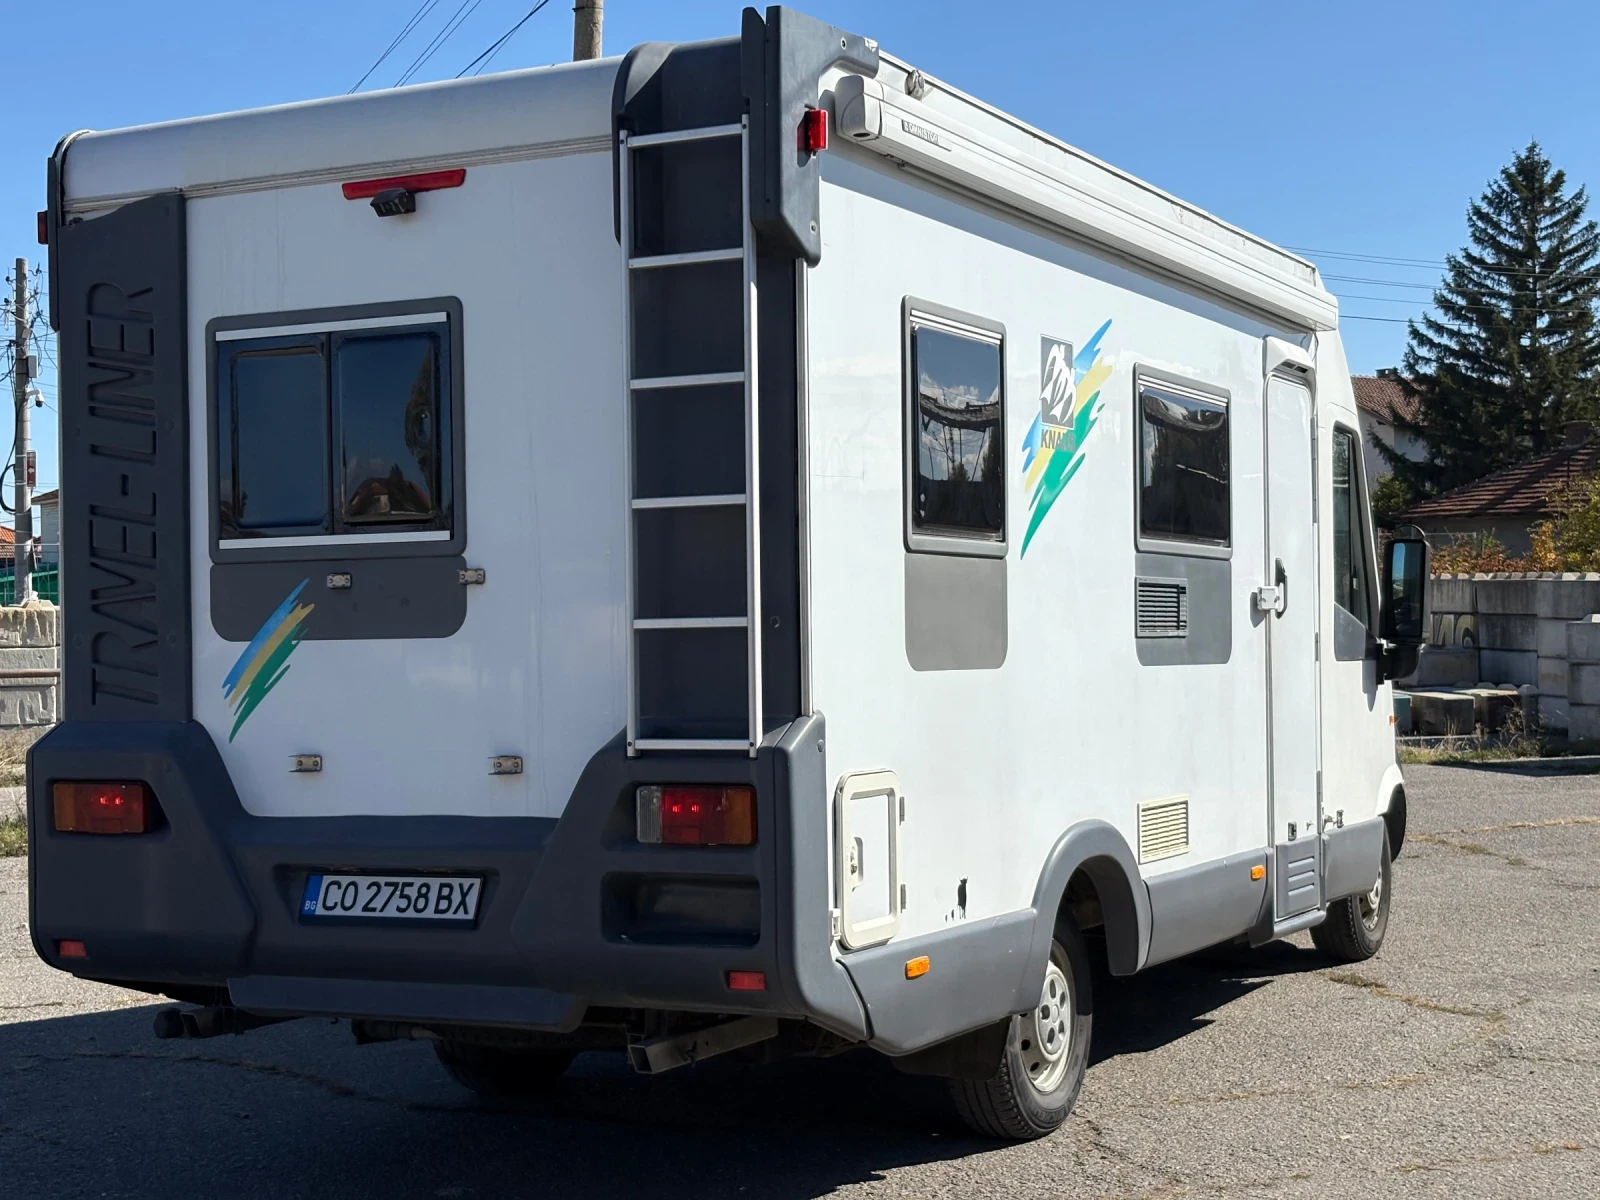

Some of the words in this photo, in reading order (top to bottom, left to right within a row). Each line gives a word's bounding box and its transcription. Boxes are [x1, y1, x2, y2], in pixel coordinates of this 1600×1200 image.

[87, 282, 159, 706] TRAVEL-LINER
[304, 900, 317, 910] BG
[321, 880, 359, 912] CO
[361, 881, 431, 914] 2758
[433, 882, 475, 915] BX
